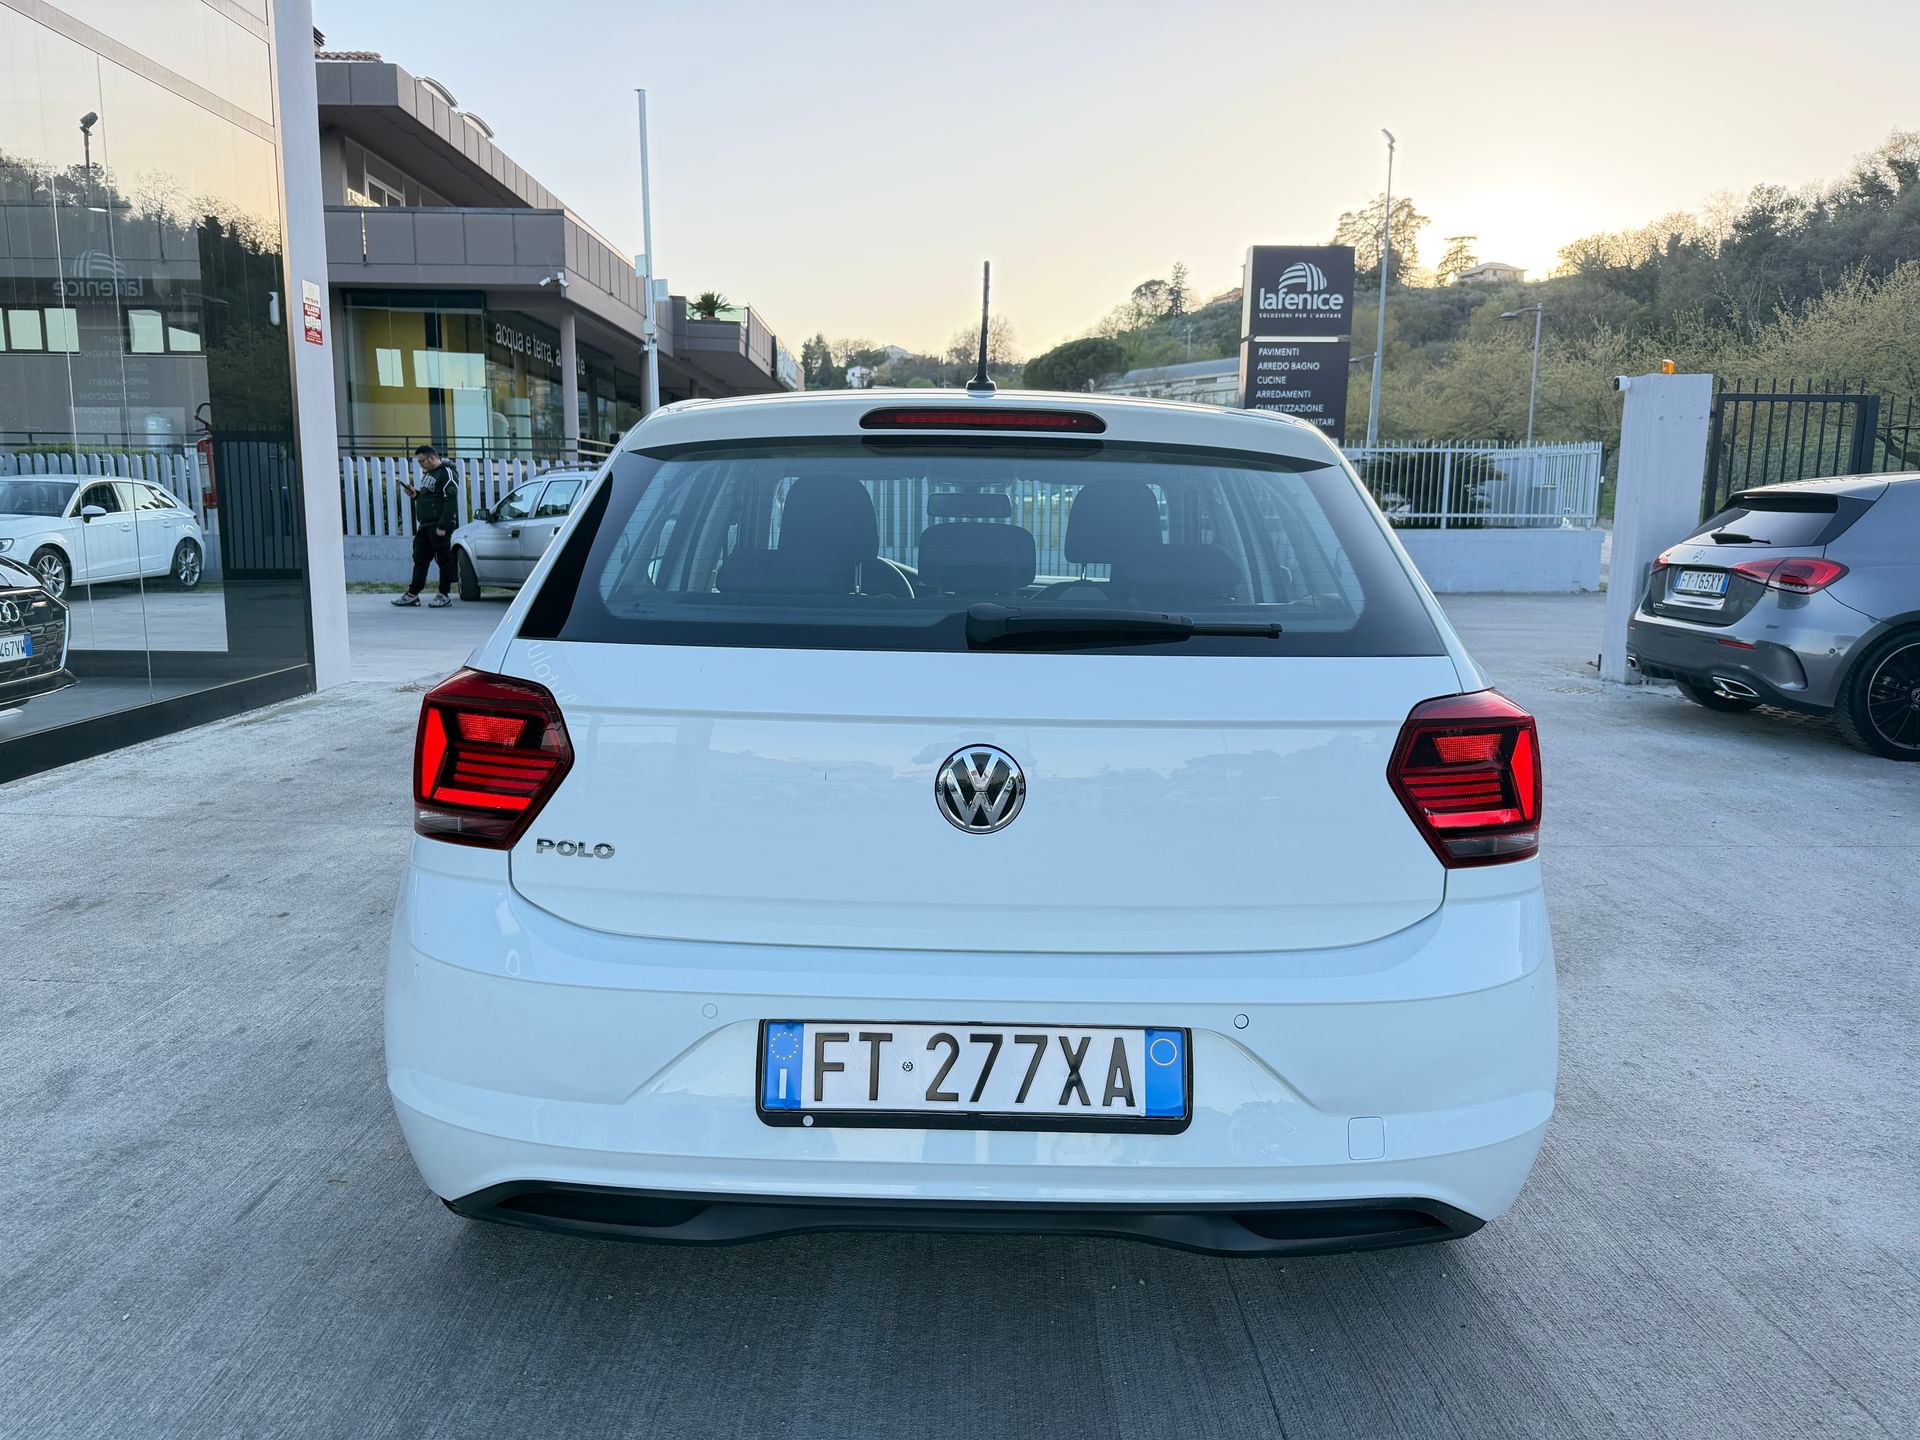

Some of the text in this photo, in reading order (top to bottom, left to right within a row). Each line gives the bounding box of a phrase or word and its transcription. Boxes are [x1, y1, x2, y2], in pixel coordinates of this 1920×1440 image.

[1259, 287, 1344, 310] lafenice
[495, 323, 524, 356] acqua
[525, 335, 532, 355] e
[533, 333, 554, 367] terra,
[1258, 347, 1299, 357] PAVIMENTI
[1257, 362, 1320, 371] ARREDO BAGNO
[1256, 376, 1287, 385] CUCINE
[1255, 390, 1312, 399] ARREDAMENTI
[937, 747, 1024, 831] VW
[535, 838, 616, 860] POLO
